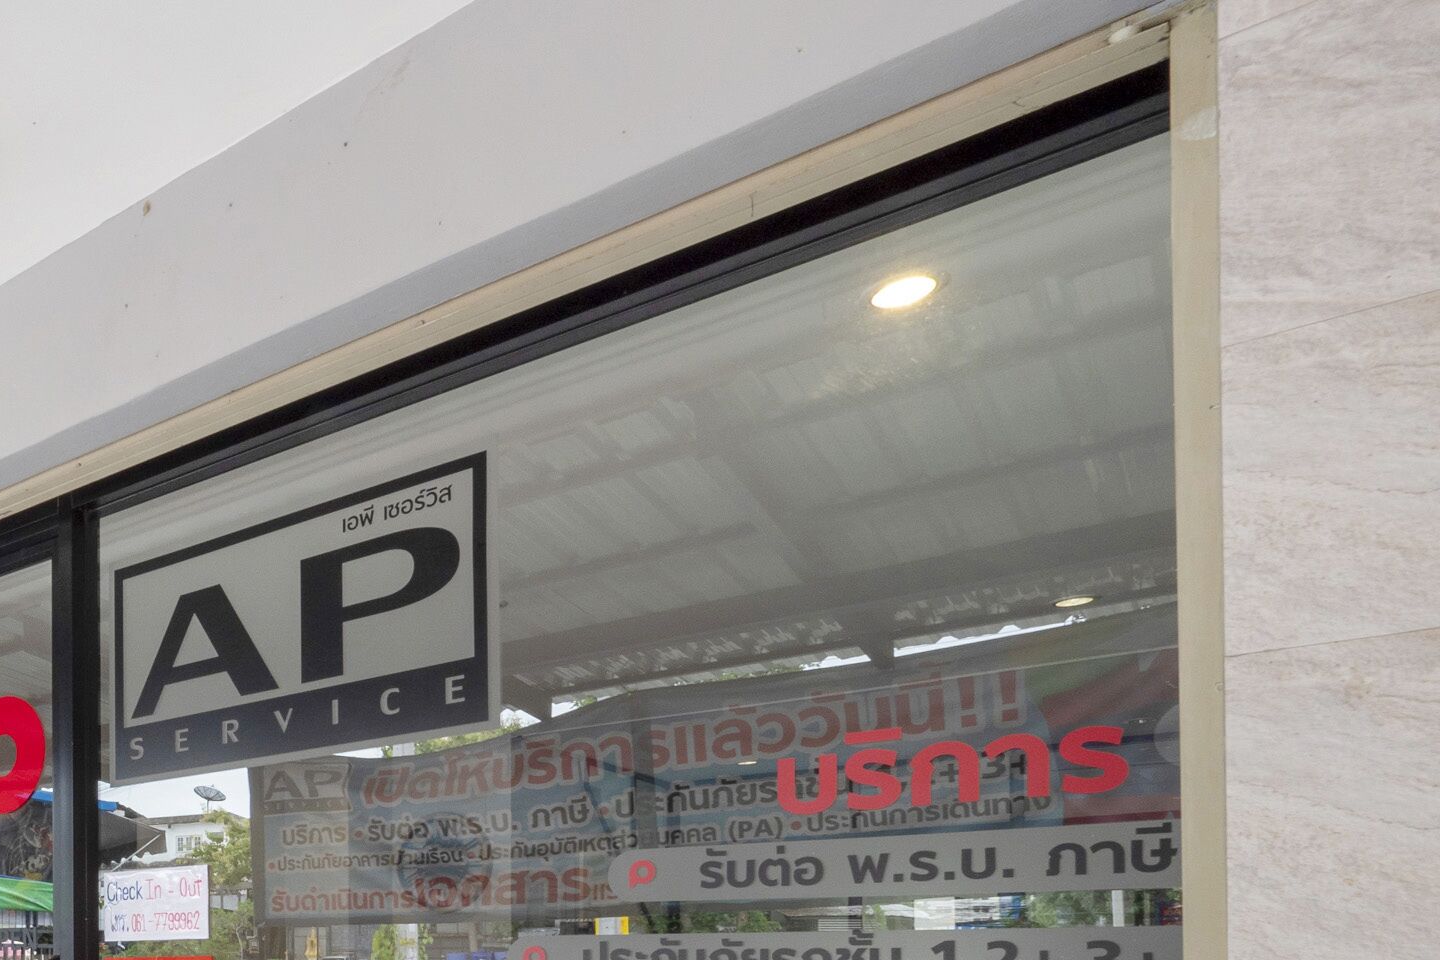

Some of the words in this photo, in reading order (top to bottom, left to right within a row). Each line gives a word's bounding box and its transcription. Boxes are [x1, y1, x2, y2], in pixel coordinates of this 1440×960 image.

[342, 505, 374, 533] เอพี
[131, 526, 461, 720] AP
[129, 675, 466, 760] SERVICE
[264, 769, 343, 800] AP
[776, 726, 1131, 815] บริการ
[281, 822, 345, 847] บริการ
[531, 796, 589, 829] ภาษี
[728, 815, 783, 844] (PA)
[699, 846, 824, 889] รับต่อ
[848, 847, 1015, 886] พ.ร.บ.
[1046, 821, 1178, 877] ภาษี
[107, 880, 143, 902] Check
[146, 879, 162, 900] In
